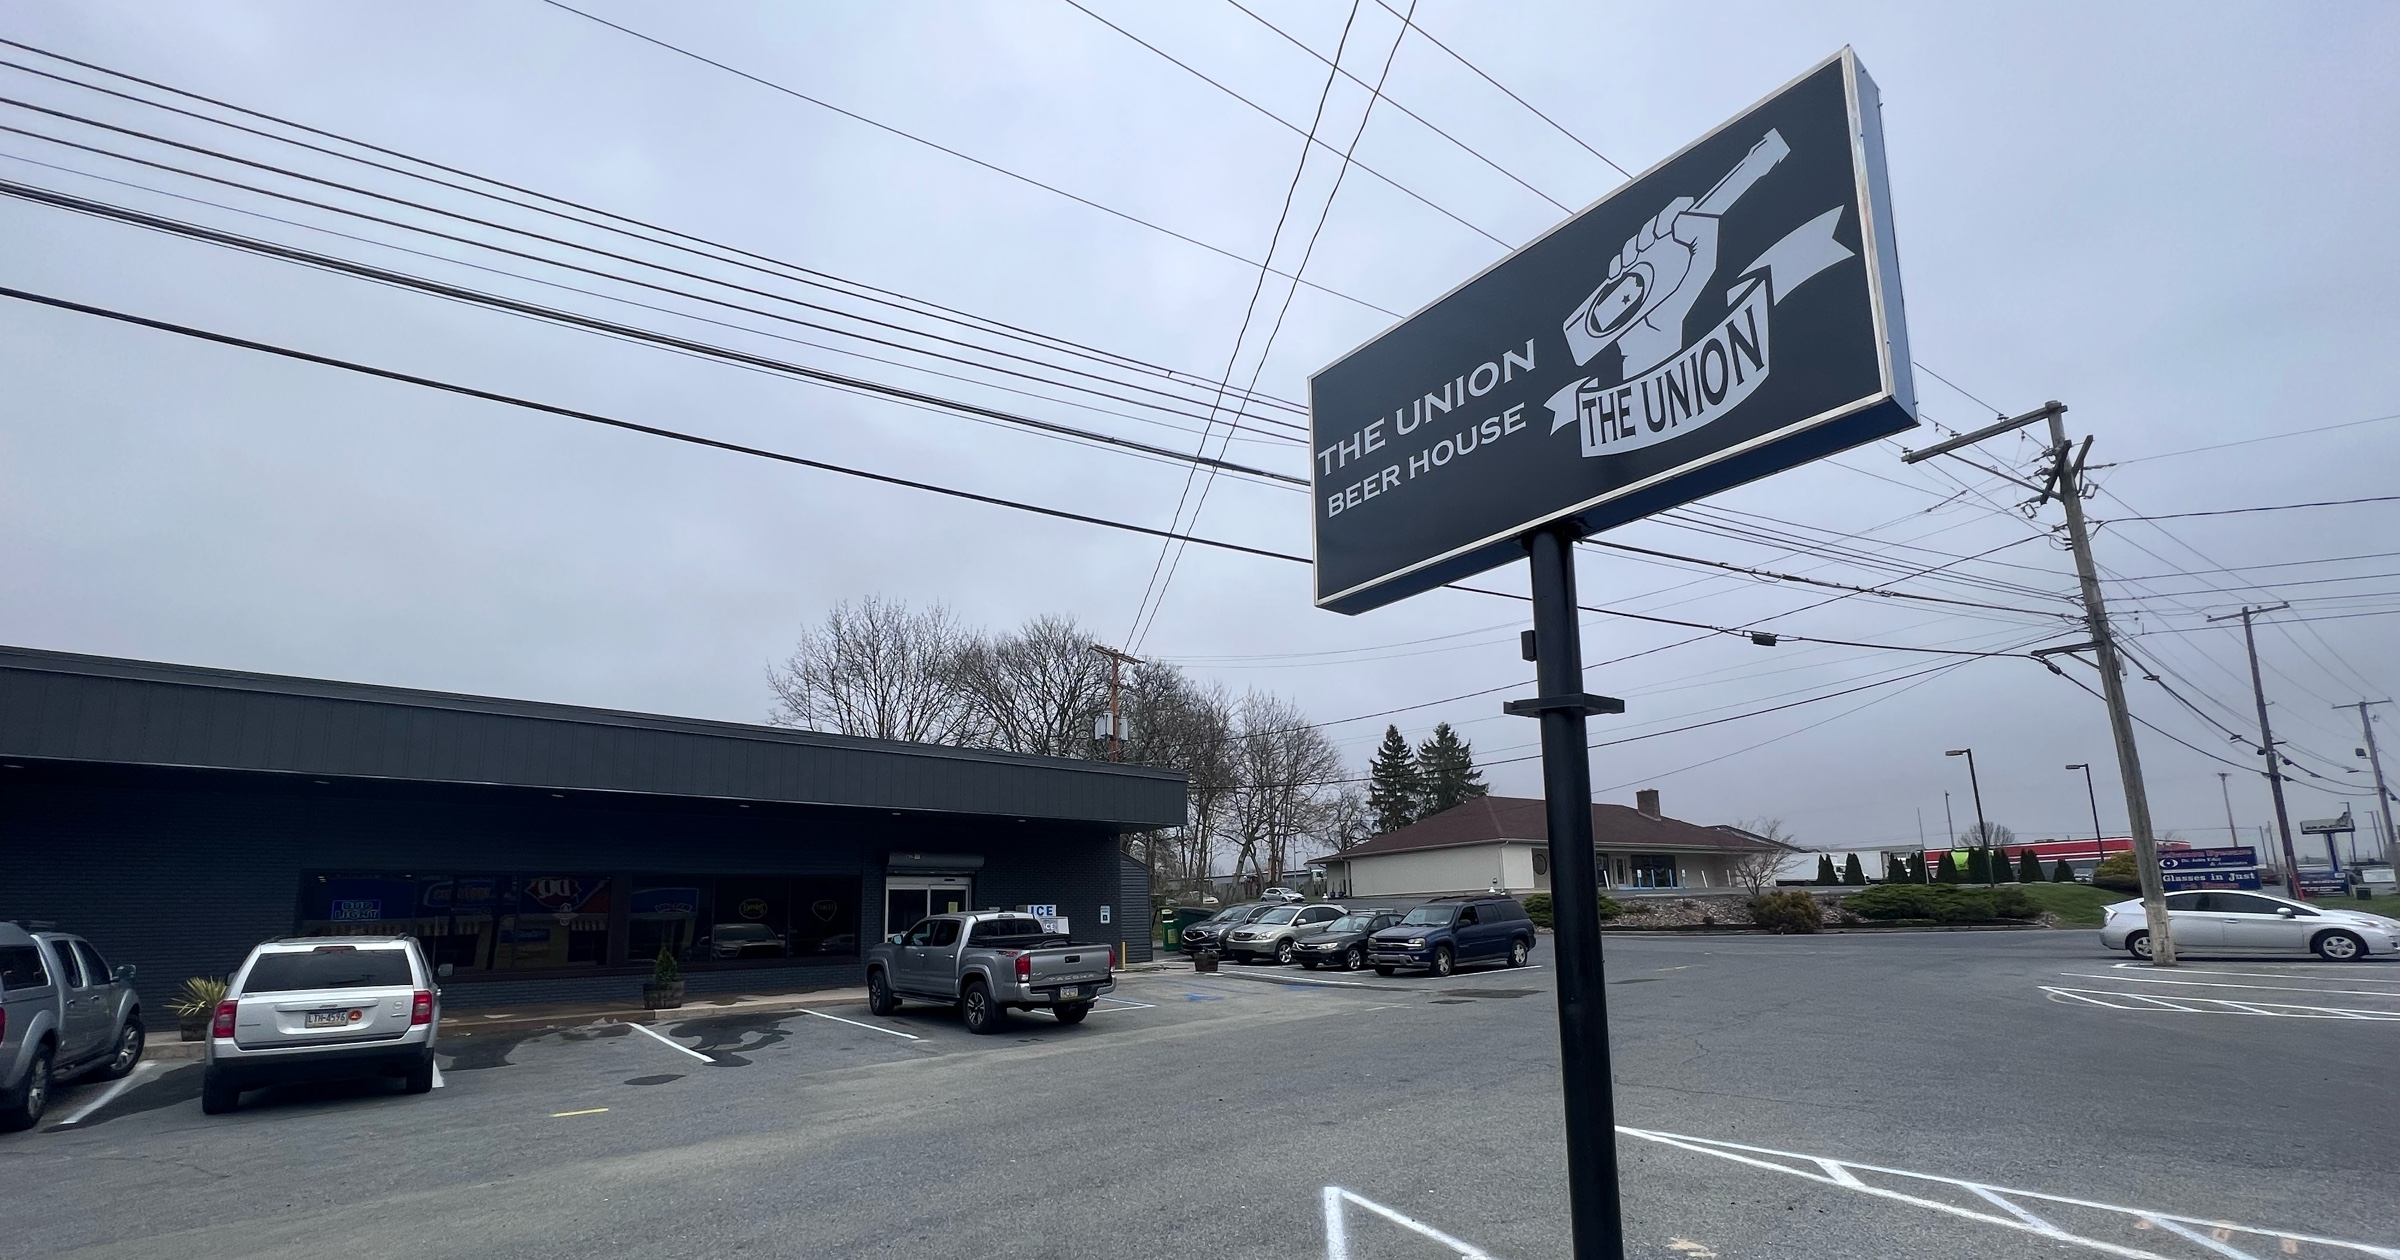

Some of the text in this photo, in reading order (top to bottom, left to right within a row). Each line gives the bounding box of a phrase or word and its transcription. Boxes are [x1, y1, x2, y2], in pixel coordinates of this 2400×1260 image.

[1581, 304, 1765, 447] THE UNION
[1318, 338, 1537, 476] THE UNION
[1328, 401, 1526, 518] BEER HOUSE
[2162, 871, 2256, 882] Glasses in Just
[341, 901, 374, 911] BUD
[1031, 906, 1053, 916] ICE
[335, 909, 380, 919] LIGHT
[1049, 973, 1095, 982] TACOMA
